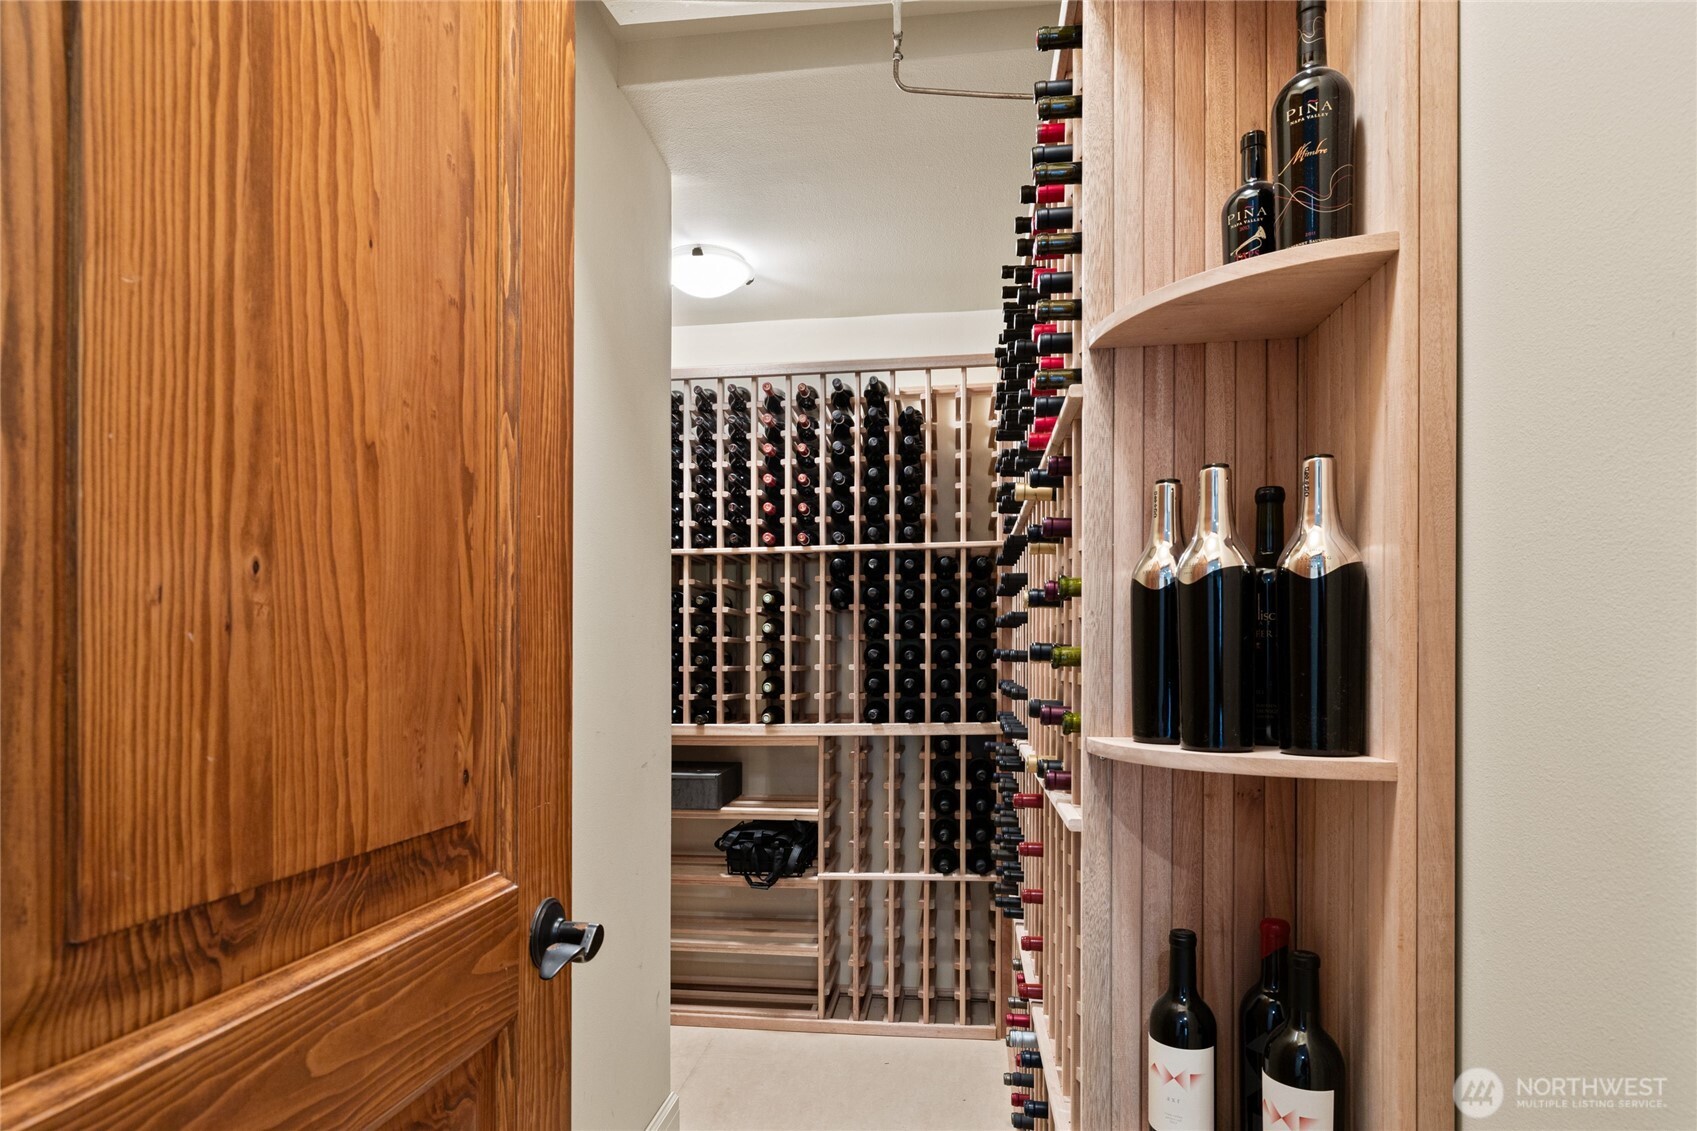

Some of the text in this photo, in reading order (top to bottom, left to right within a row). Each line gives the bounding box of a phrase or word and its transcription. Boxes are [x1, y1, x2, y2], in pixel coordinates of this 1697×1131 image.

[1286, 99, 1333, 122] PIÑA
[1290, 112, 1329, 126] NAPA VALLEY
[1227, 205, 1267, 226] PIÑA
